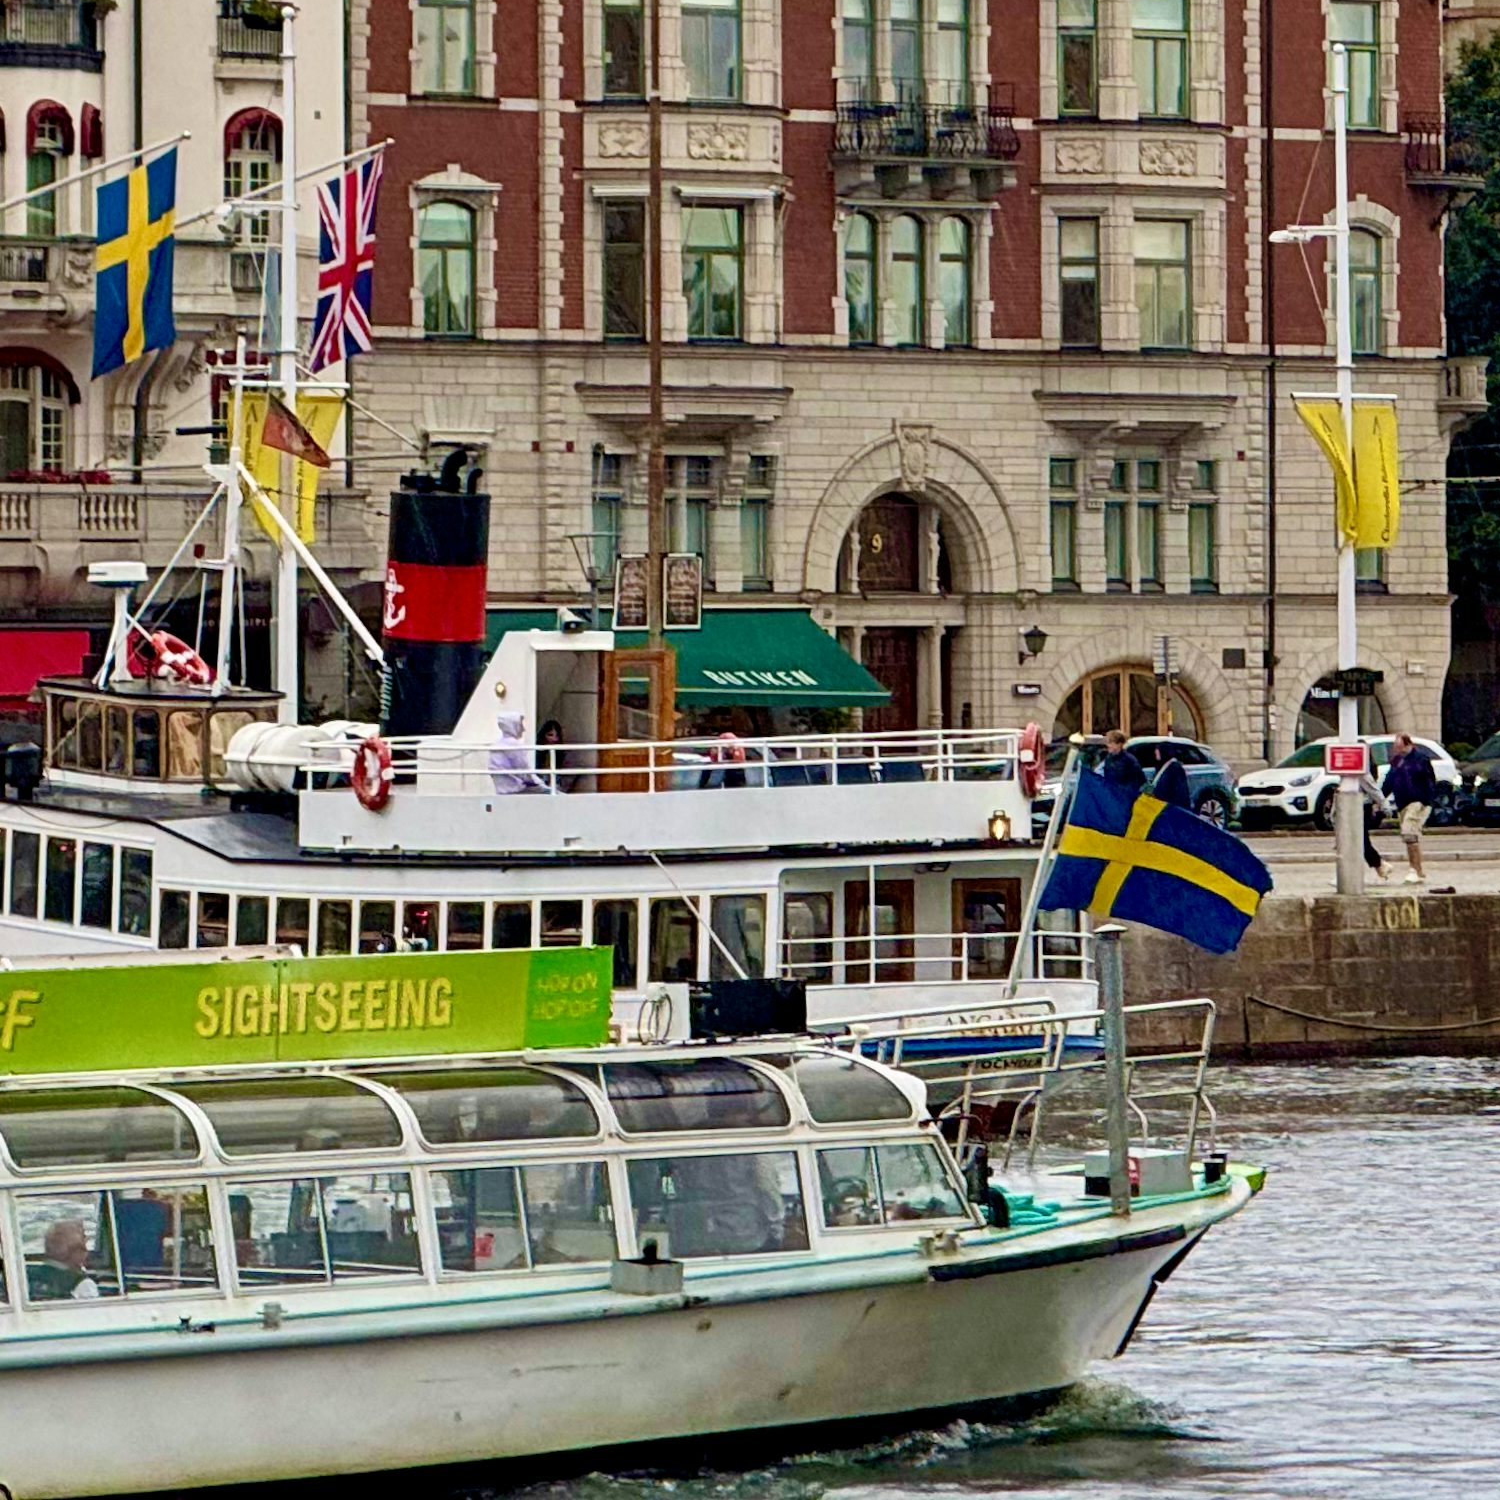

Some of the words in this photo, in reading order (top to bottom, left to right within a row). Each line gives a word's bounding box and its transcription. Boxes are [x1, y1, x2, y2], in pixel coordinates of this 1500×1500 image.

[871, 533, 883, 554] 9
[702, 669, 819, 686] BUTIKEN
[572, 972, 598, 994] ON
[0, 990, 41, 1050] F
[195, 977, 453, 1038] SIGHTSEEING
